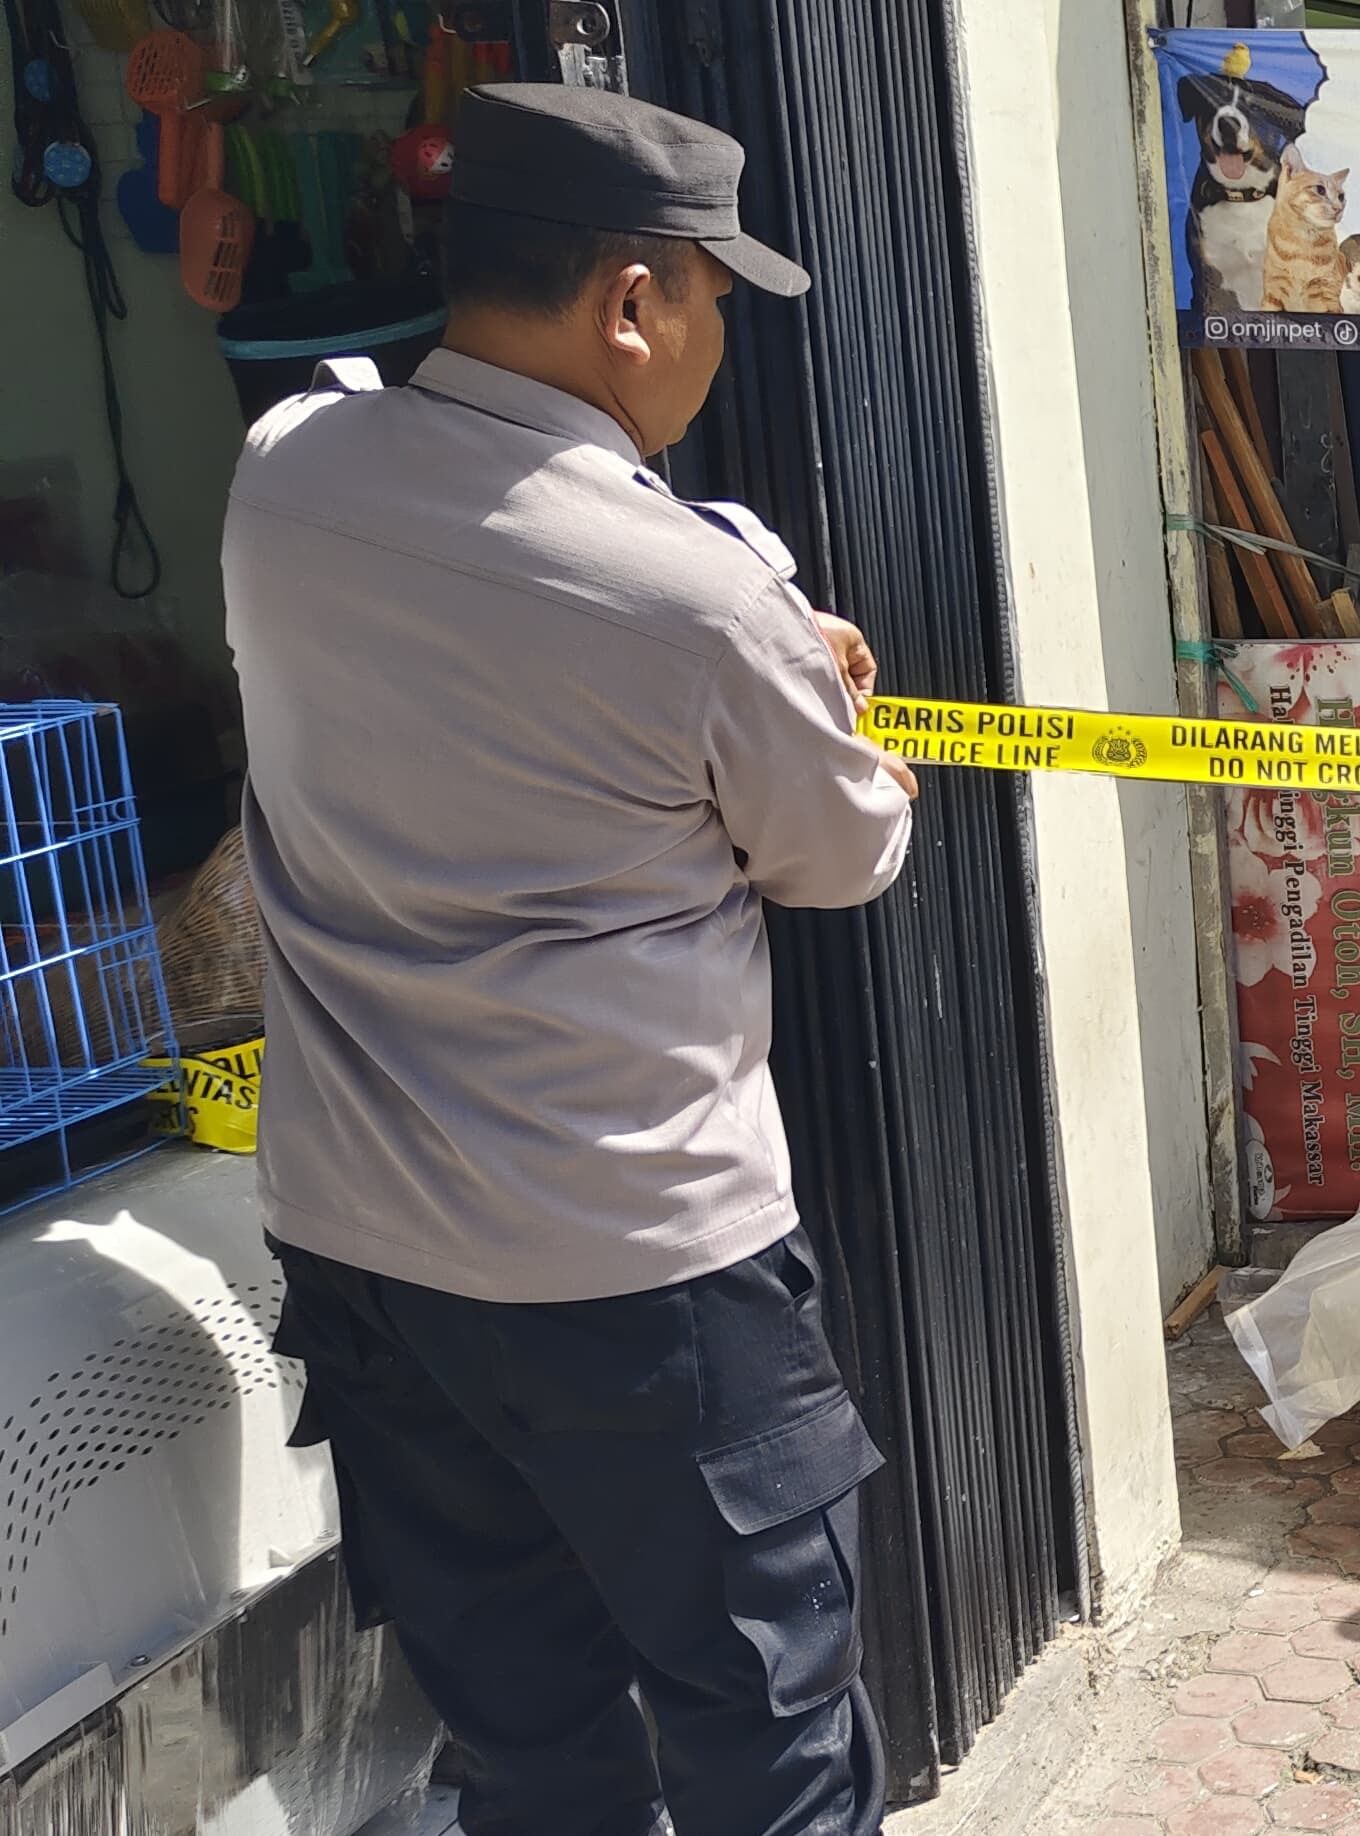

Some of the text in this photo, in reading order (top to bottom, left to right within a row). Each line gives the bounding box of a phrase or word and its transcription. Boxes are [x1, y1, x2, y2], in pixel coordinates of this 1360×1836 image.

[1232, 320, 1323, 342] omjinpet
[873, 704, 1074, 740] GARIS POLISI
[883, 737, 1061, 768] POLICE LINE
[1171, 725, 1303, 754] DILARANG
[1209, 756, 1243, 780] DO
[1256, 758, 1307, 783] NOT
[1273, 790, 1326, 1187] inggi Pengadilan Tinggi Makassar
